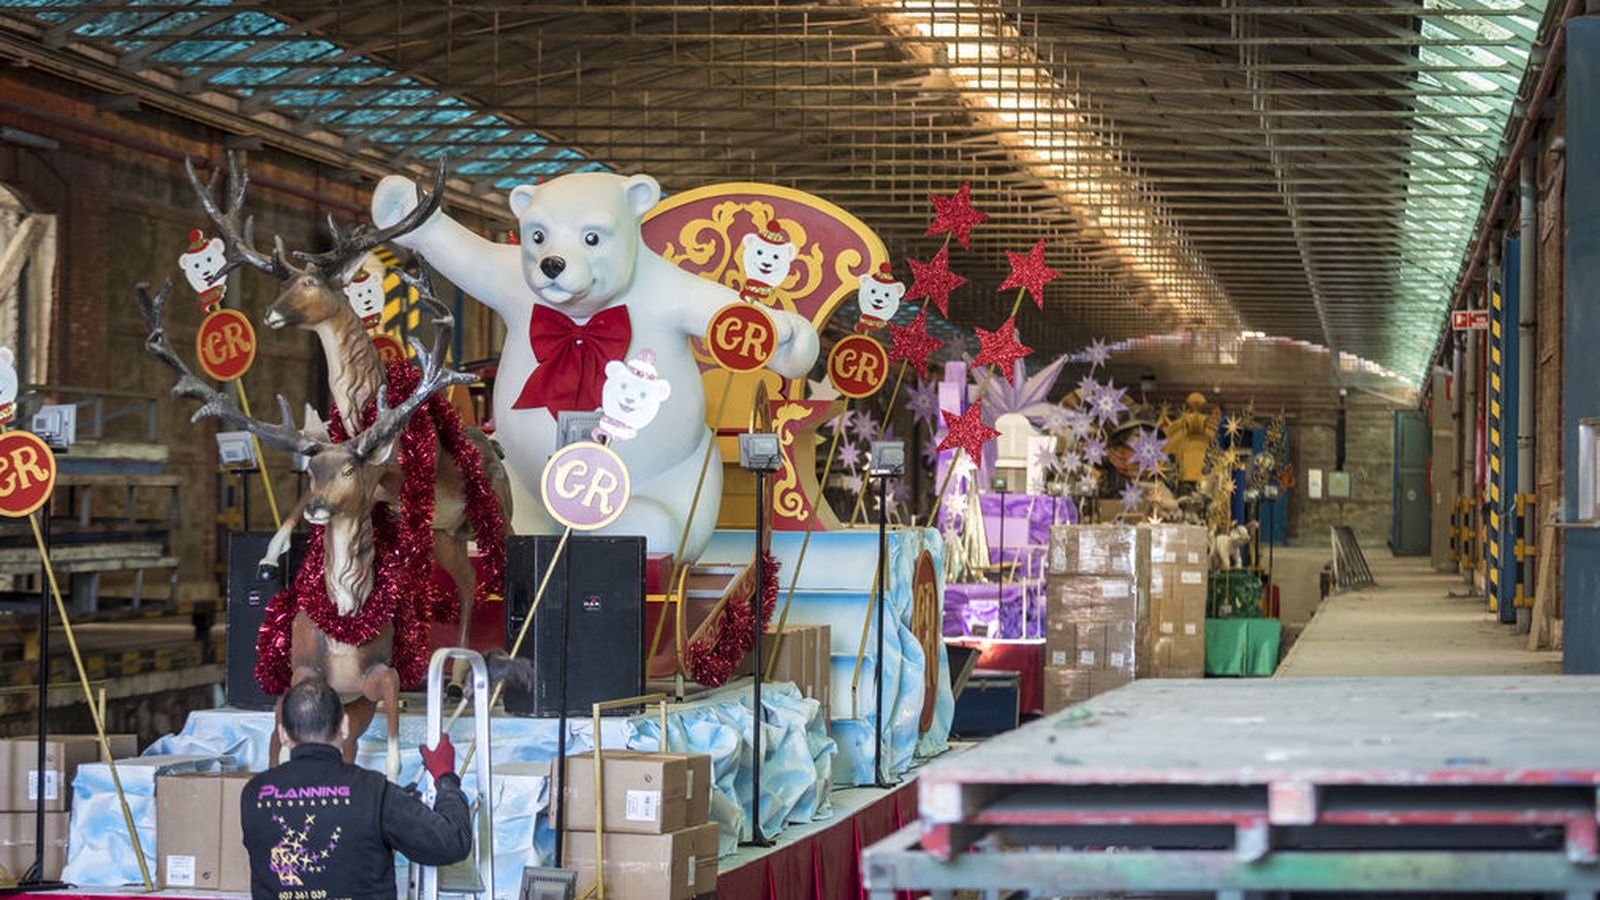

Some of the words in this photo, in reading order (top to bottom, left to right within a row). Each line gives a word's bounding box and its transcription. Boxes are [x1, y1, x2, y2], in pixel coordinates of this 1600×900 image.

[203, 322, 252, 365] GR
[716, 317, 767, 361] GR
[835, 348, 878, 386] GR
[555, 460, 618, 515] GR
